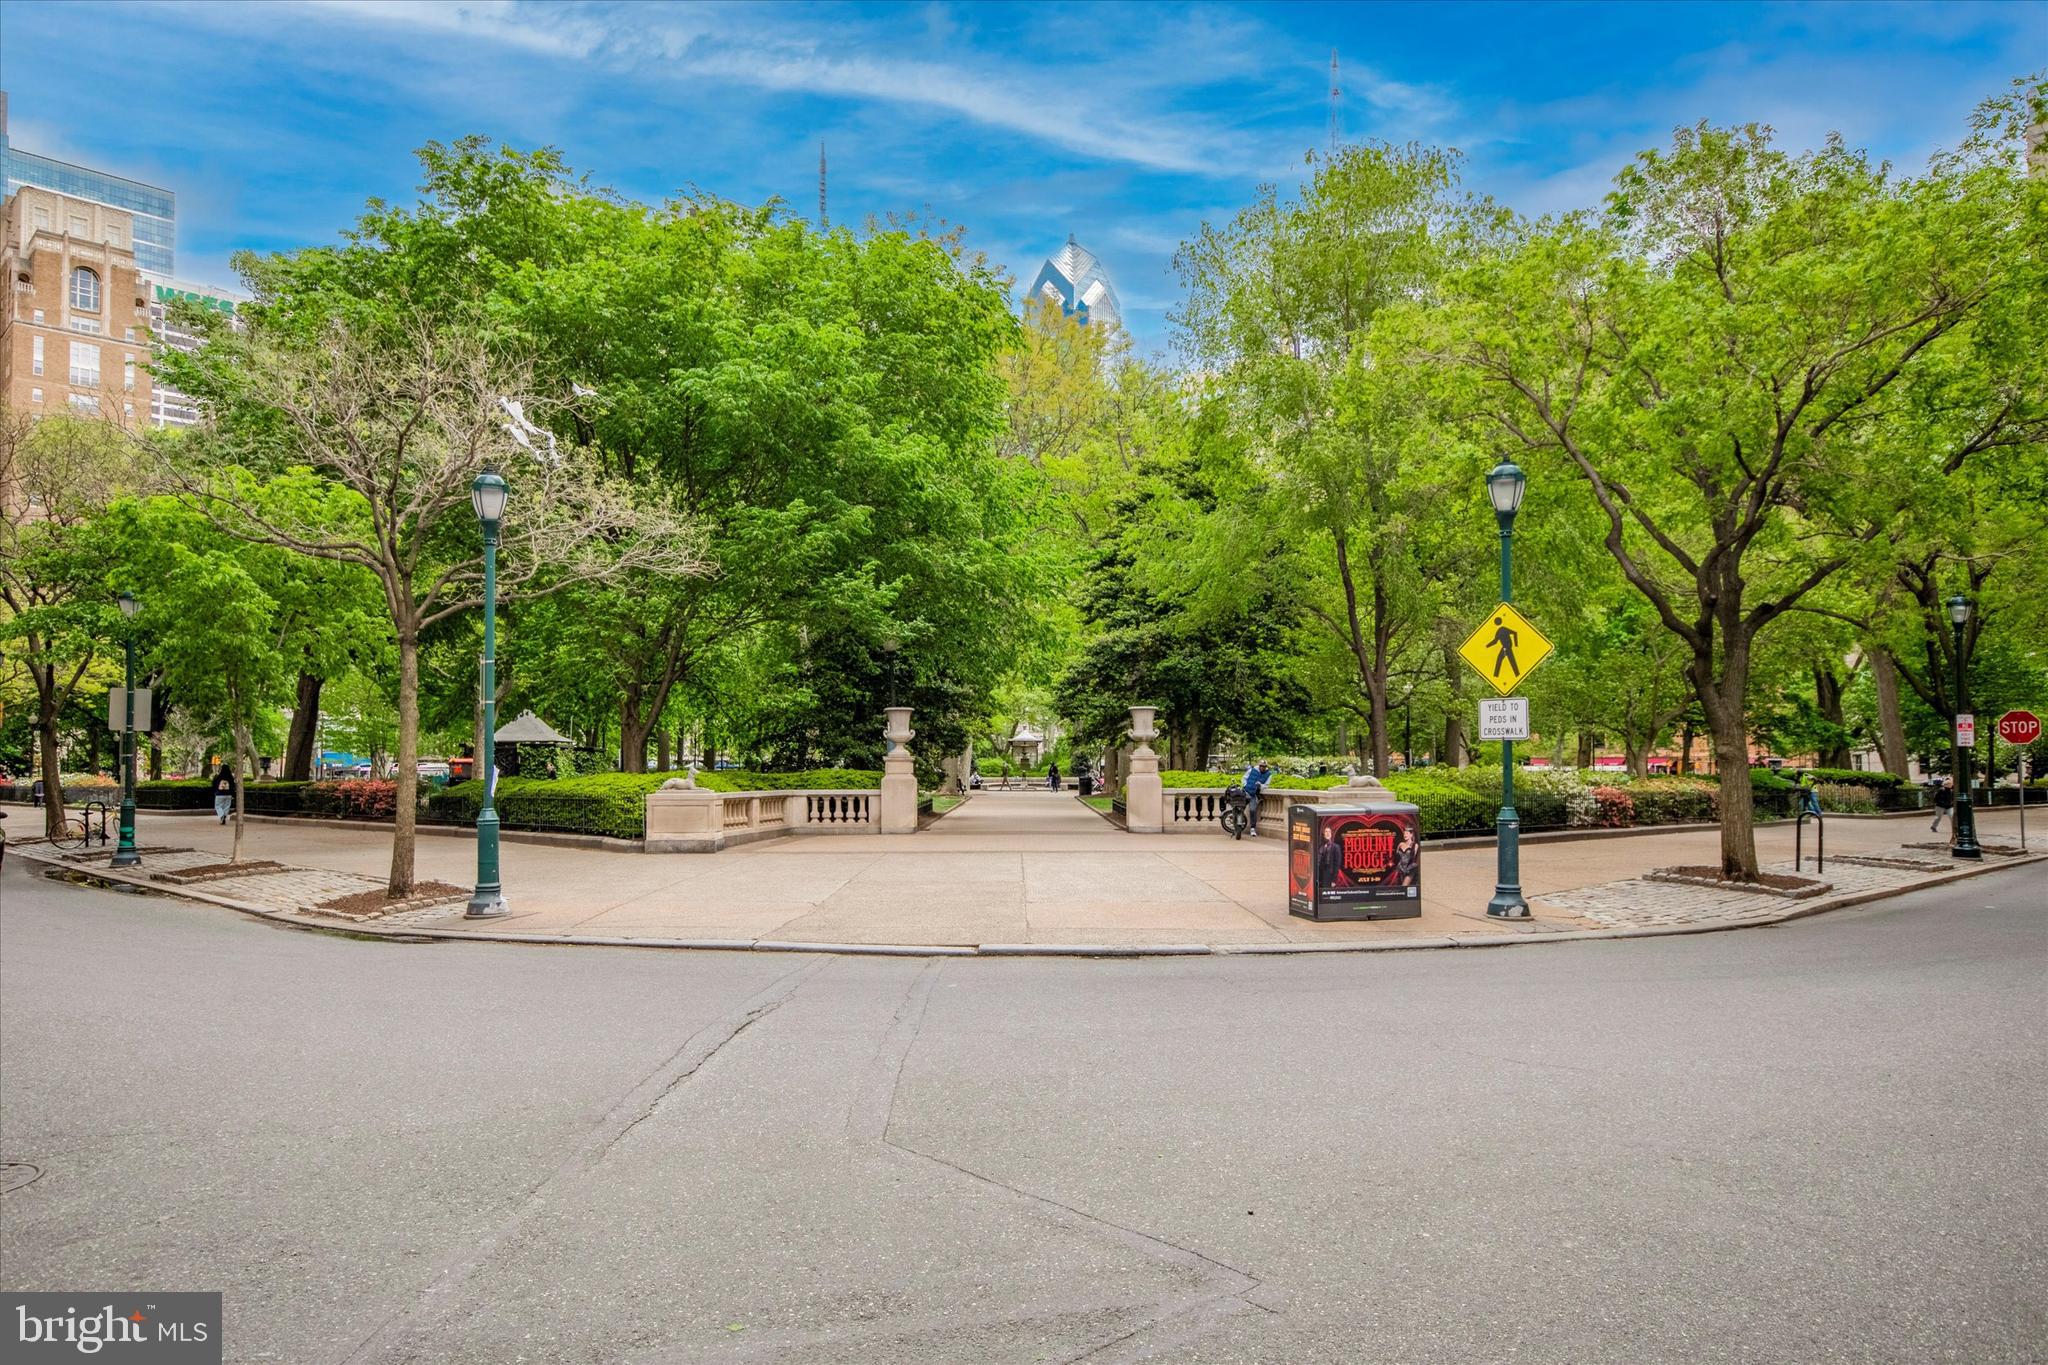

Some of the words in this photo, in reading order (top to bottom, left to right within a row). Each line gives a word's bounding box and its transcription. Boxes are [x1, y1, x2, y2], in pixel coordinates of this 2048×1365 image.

[1488, 703, 1507, 711] YIELD
[1511, 702, 1519, 711] TO
[1489, 715, 1507, 723] PEDS
[1510, 715, 1517, 723] IN
[2001, 720, 2038, 734] STOP
[1483, 728, 1524, 736] CROSSWALK
[1344, 836, 1387, 853] MOULIN
